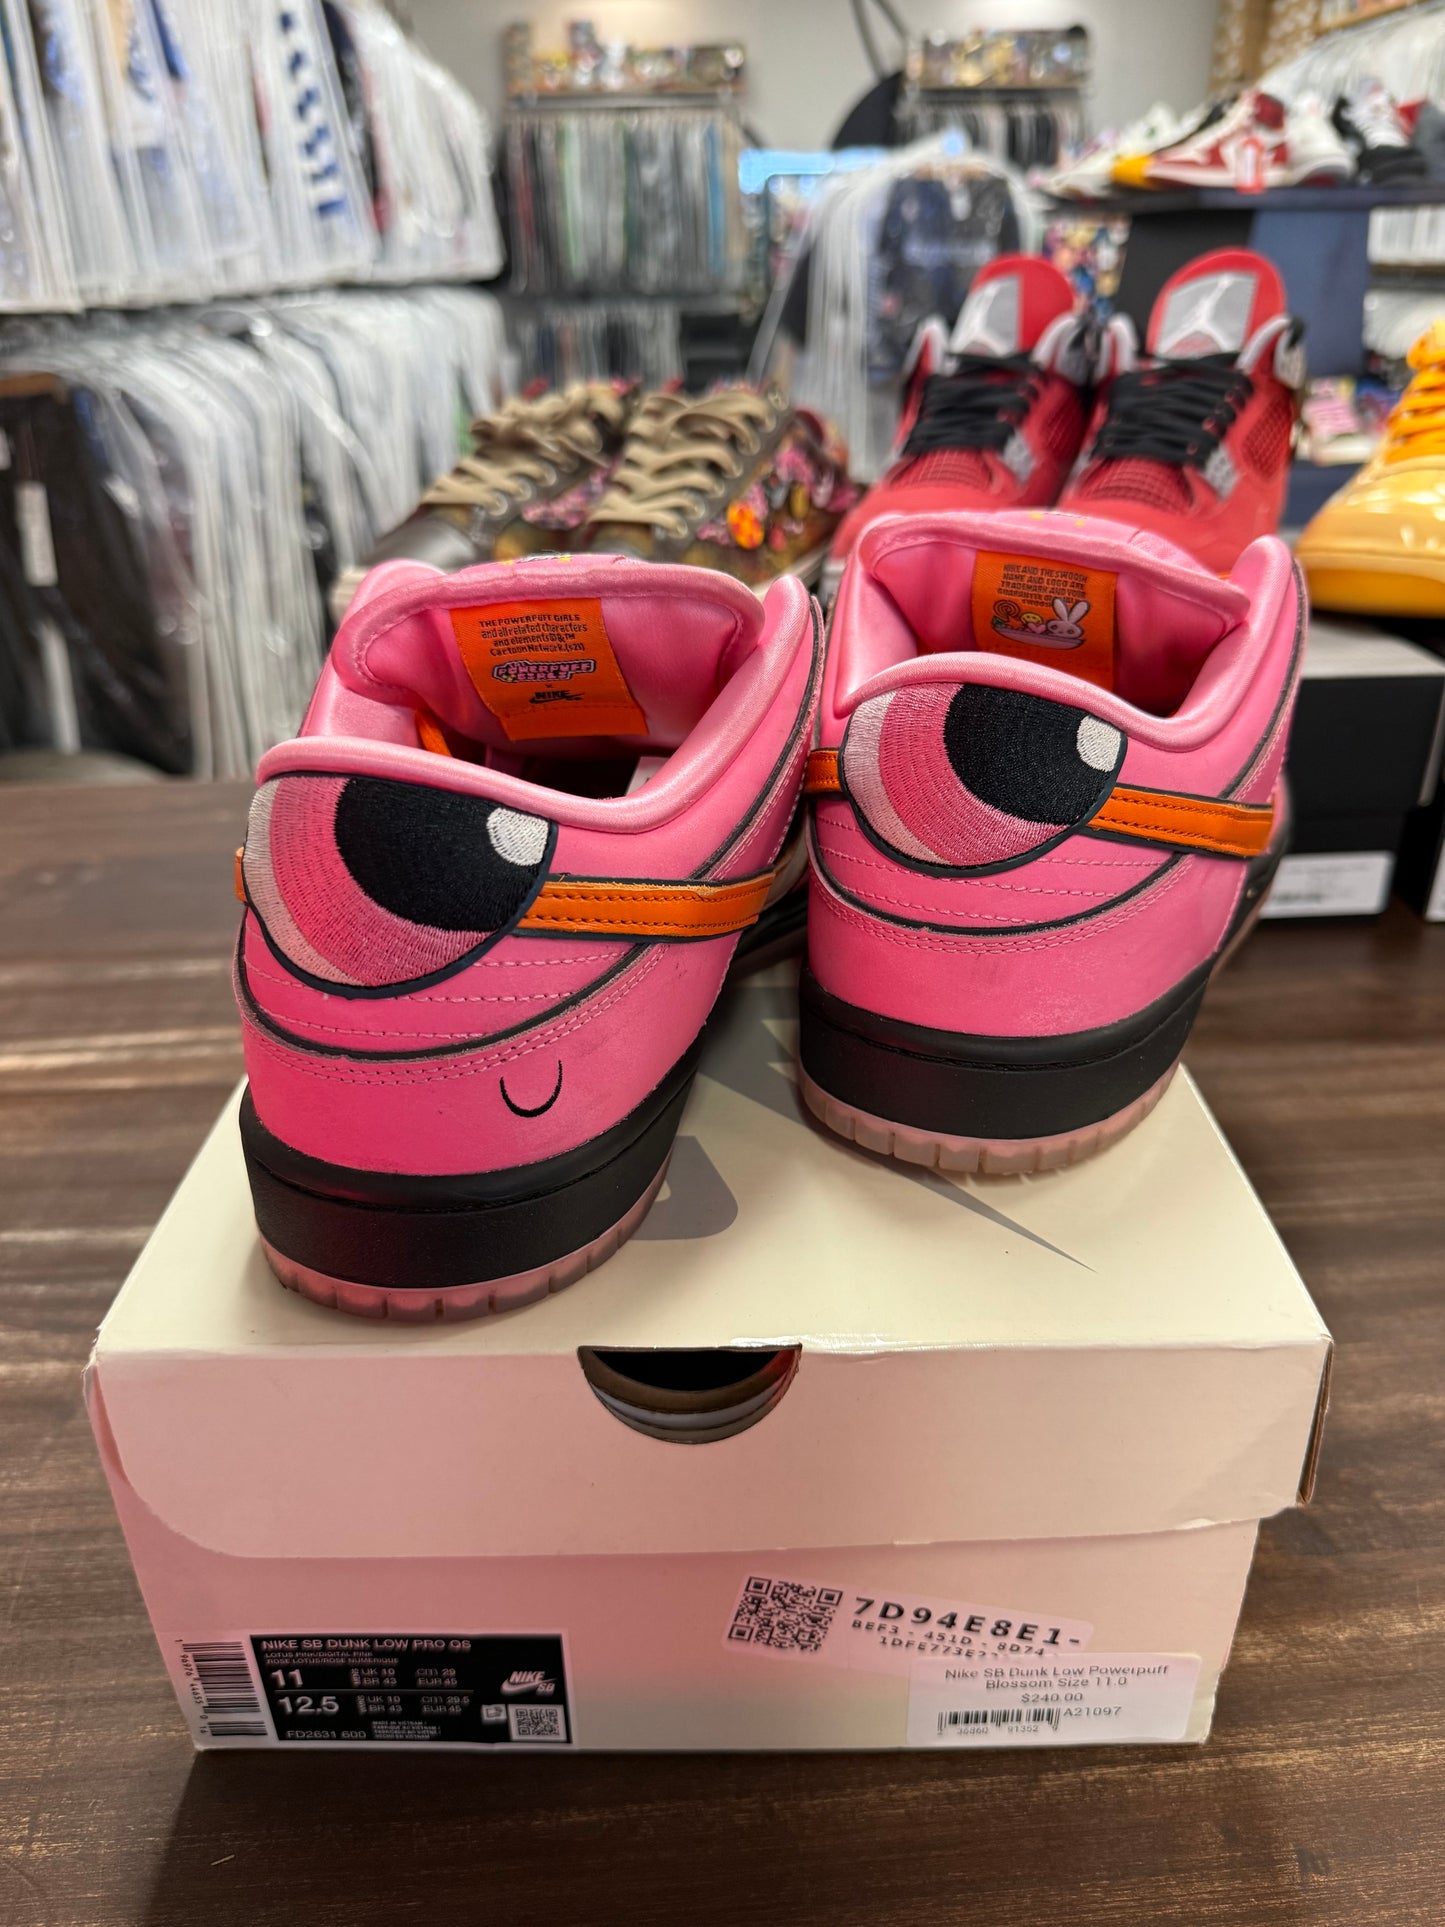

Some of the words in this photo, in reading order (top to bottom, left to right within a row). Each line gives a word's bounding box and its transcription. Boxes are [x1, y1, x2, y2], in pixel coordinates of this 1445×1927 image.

[479, 619, 497, 628] THE
[498, 614, 552, 626] POWERPUFF
[554, 614, 580, 622] GIRLS
[481, 628, 497, 639] and
[493, 637, 509, 647] and
[854, 1596, 1080, 1645] 7D94E8E1-
[262, 1640, 299, 1649] NIKE
[302, 1639, 324, 1648] SB
[327, 1639, 370, 1648] DUNK
[375, 1639, 409, 1649] LOW
[413, 1639, 446, 1648] PRO
[450, 1639, 472, 1648] QS
[271, 1669, 303, 1687] 11
[509, 1671, 546, 1682] NIKE
[945, 1668, 978, 1679] Nike
[984, 1667, 1004, 1678] SB
[1009, 1667, 1048, 1678] Dunk
[1052, 1665, 1085, 1676] Low
[364, 1677, 380, 1685] BR
[418, 1677, 442, 1685] EUR
[986, 1678, 1052, 1690] Blossom
[1058, 1677, 1089, 1687] Size
[1096, 1676, 1128, 1687] 11.0
[1021, 1692, 1084, 1704] $240.00
[278, 1696, 339, 1714] 12.5
[423, 1704, 447, 1712] EUR
[1063, 1706, 1122, 1718] A21097
[287, 1730, 336, 1739] FD2631
[343, 1730, 367, 1739] 600
